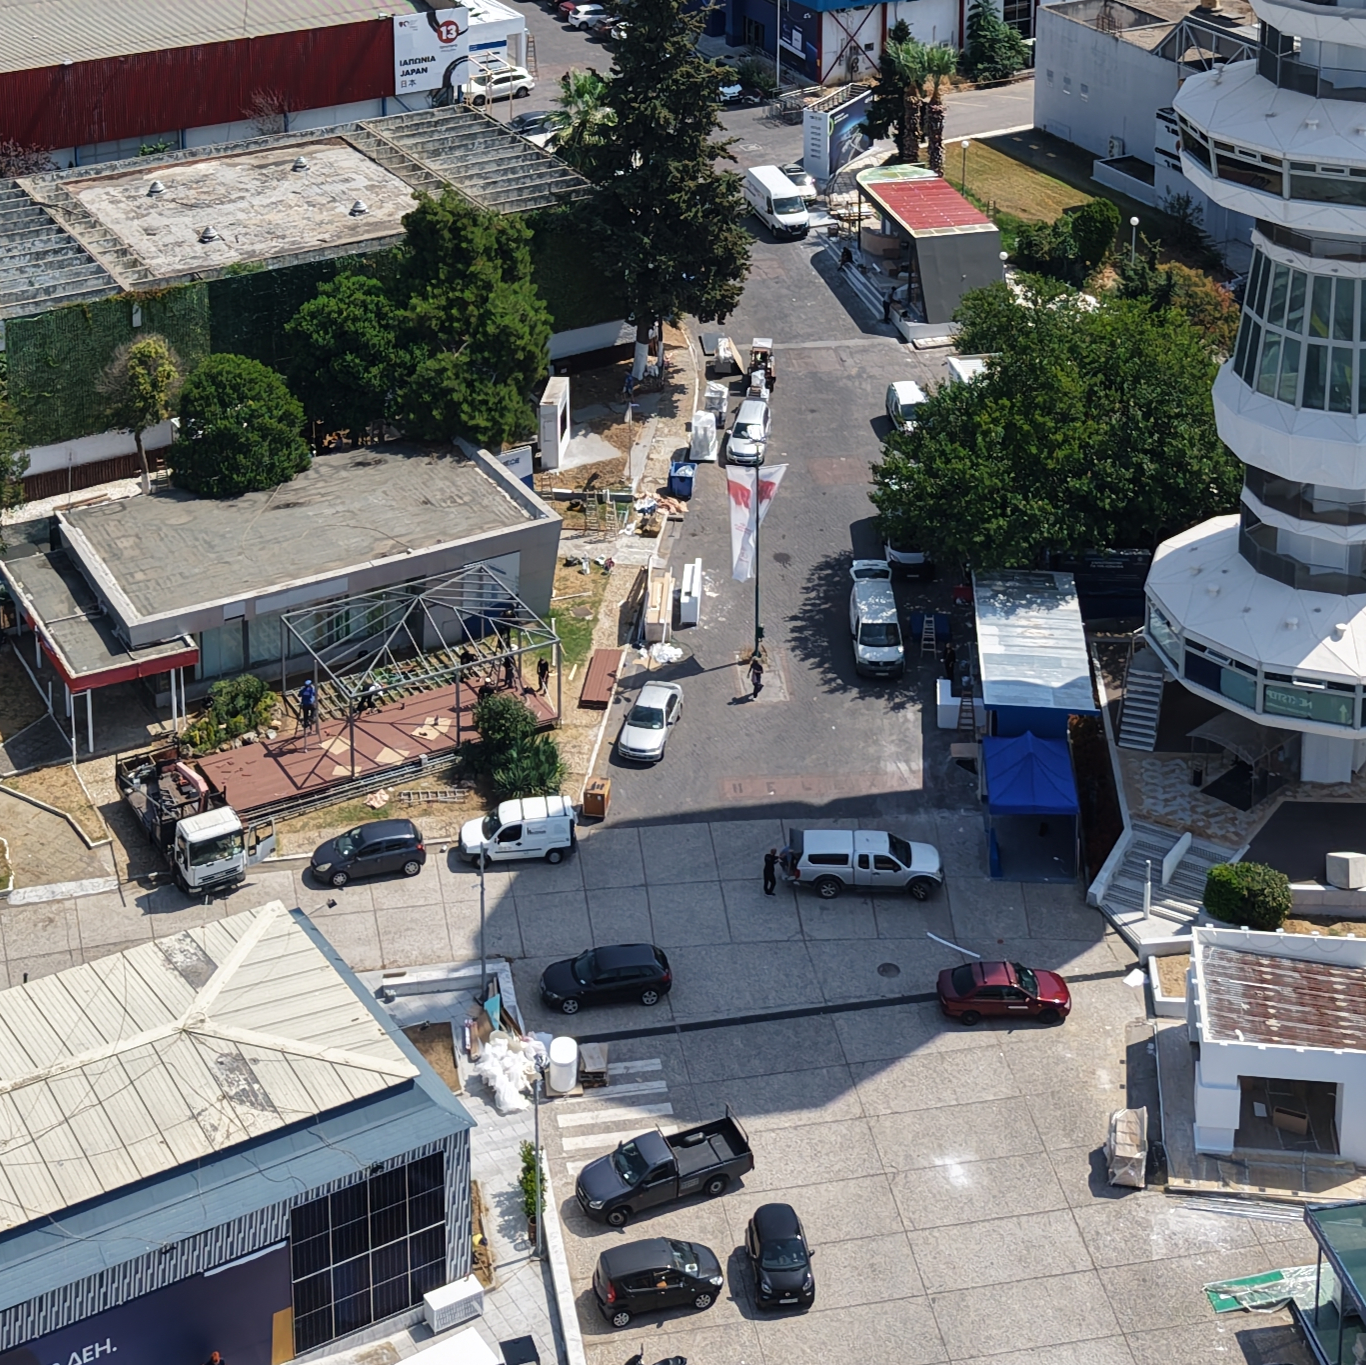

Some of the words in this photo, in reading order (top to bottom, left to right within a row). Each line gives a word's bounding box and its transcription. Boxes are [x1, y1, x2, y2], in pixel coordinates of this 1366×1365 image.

[440, 24, 458, 39] 13
[399, 55, 436, 67] ΙΑΠΩΝΙΑ
[400, 67, 428, 77] JAPAN
[400, 79, 417, 88] 日本
